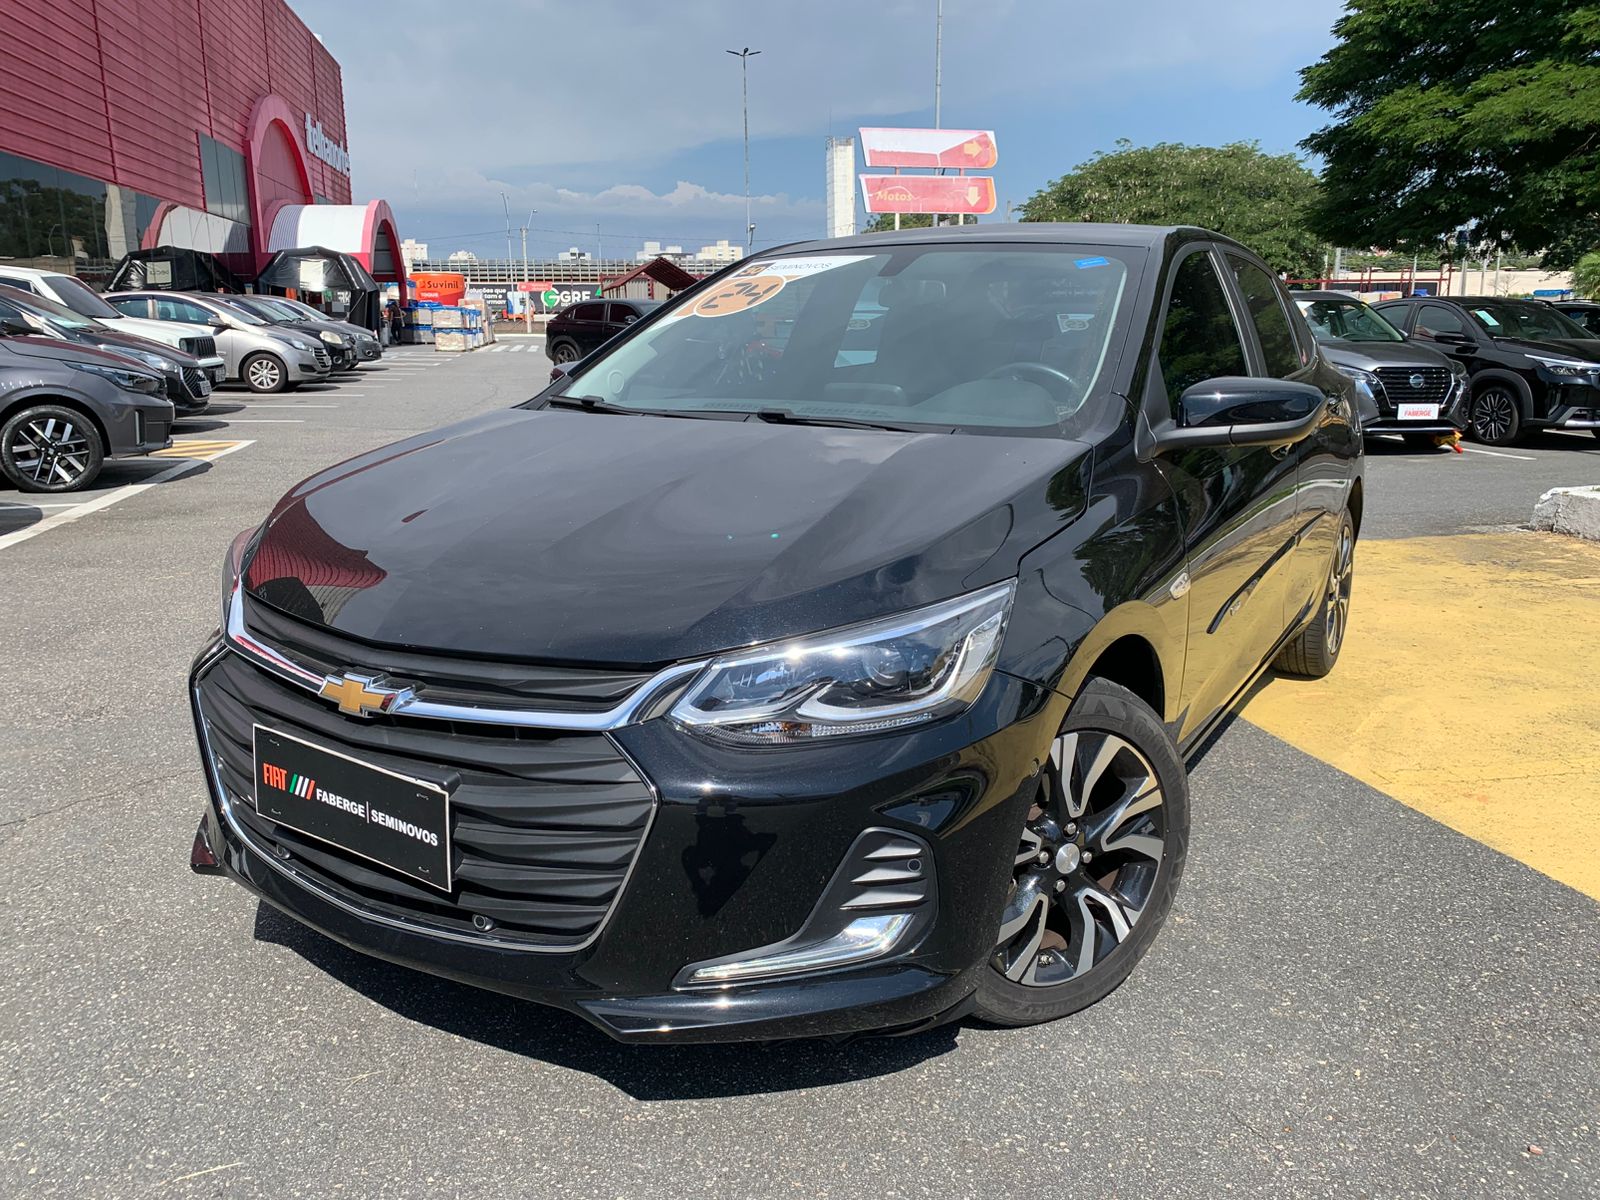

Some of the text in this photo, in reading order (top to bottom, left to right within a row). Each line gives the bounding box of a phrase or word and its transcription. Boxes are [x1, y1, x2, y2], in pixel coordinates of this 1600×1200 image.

[876, 190, 912, 202] Motos
[427, 281, 458, 289] Suvinil
[263, 762, 438, 846] FIAT FABERGE SEMINOVOS
